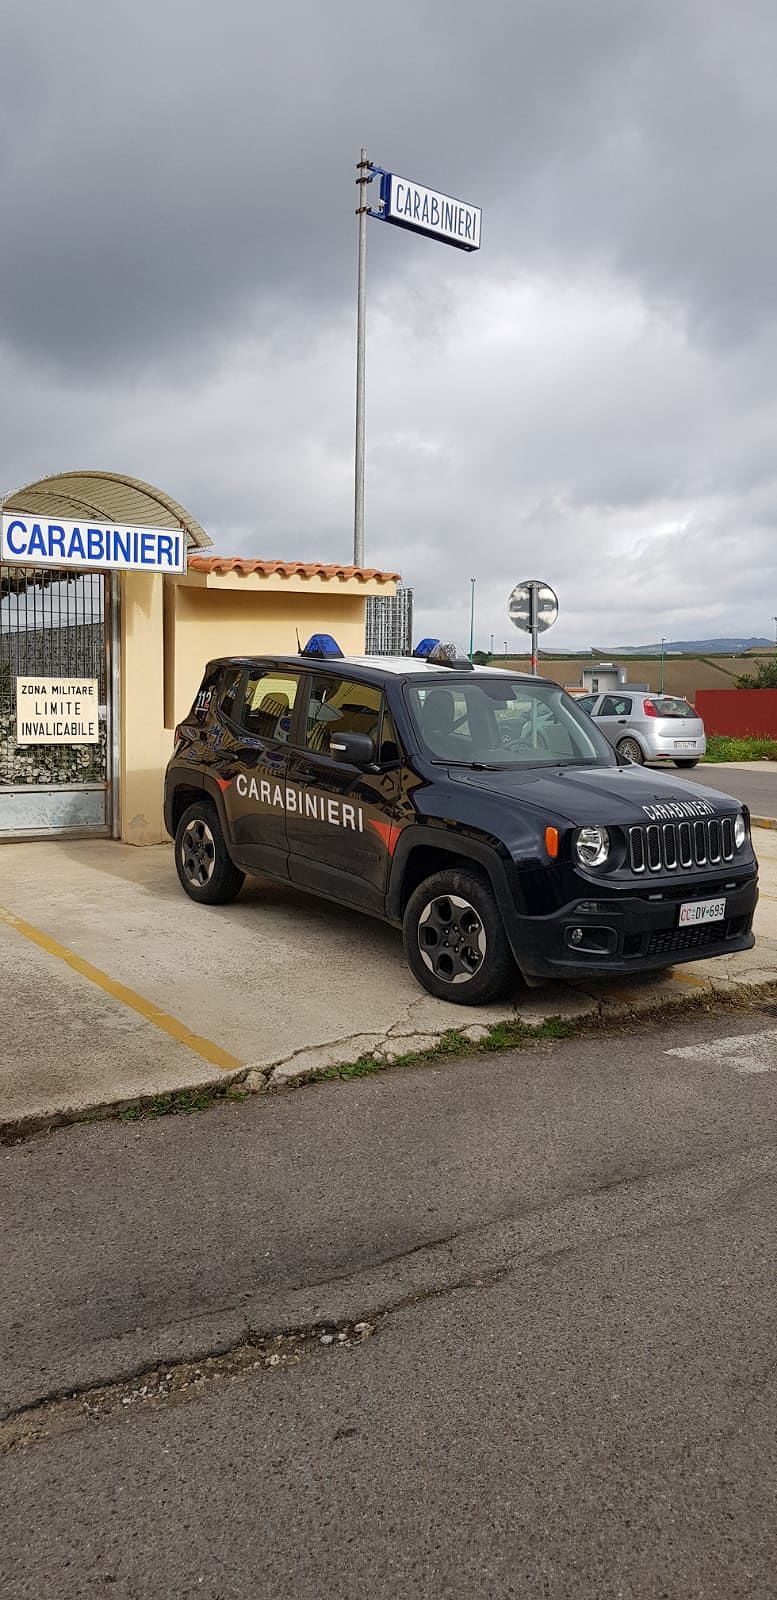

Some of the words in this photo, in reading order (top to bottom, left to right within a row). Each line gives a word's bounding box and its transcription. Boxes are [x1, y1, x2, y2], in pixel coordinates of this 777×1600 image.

[396, 184, 477, 240] CARABINIERI
[6, 520, 180, 567] CARABINIERI
[21, 685, 47, 695] ZONA
[51, 685, 94, 695] MILITARE
[196, 690, 212, 708] 112
[35, 702, 81, 716] LIMITE
[21, 722, 95, 737] INVALICABILE
[236, 774, 364, 833] CARABINIERI
[642, 801, 715, 821] CARABINIERI
